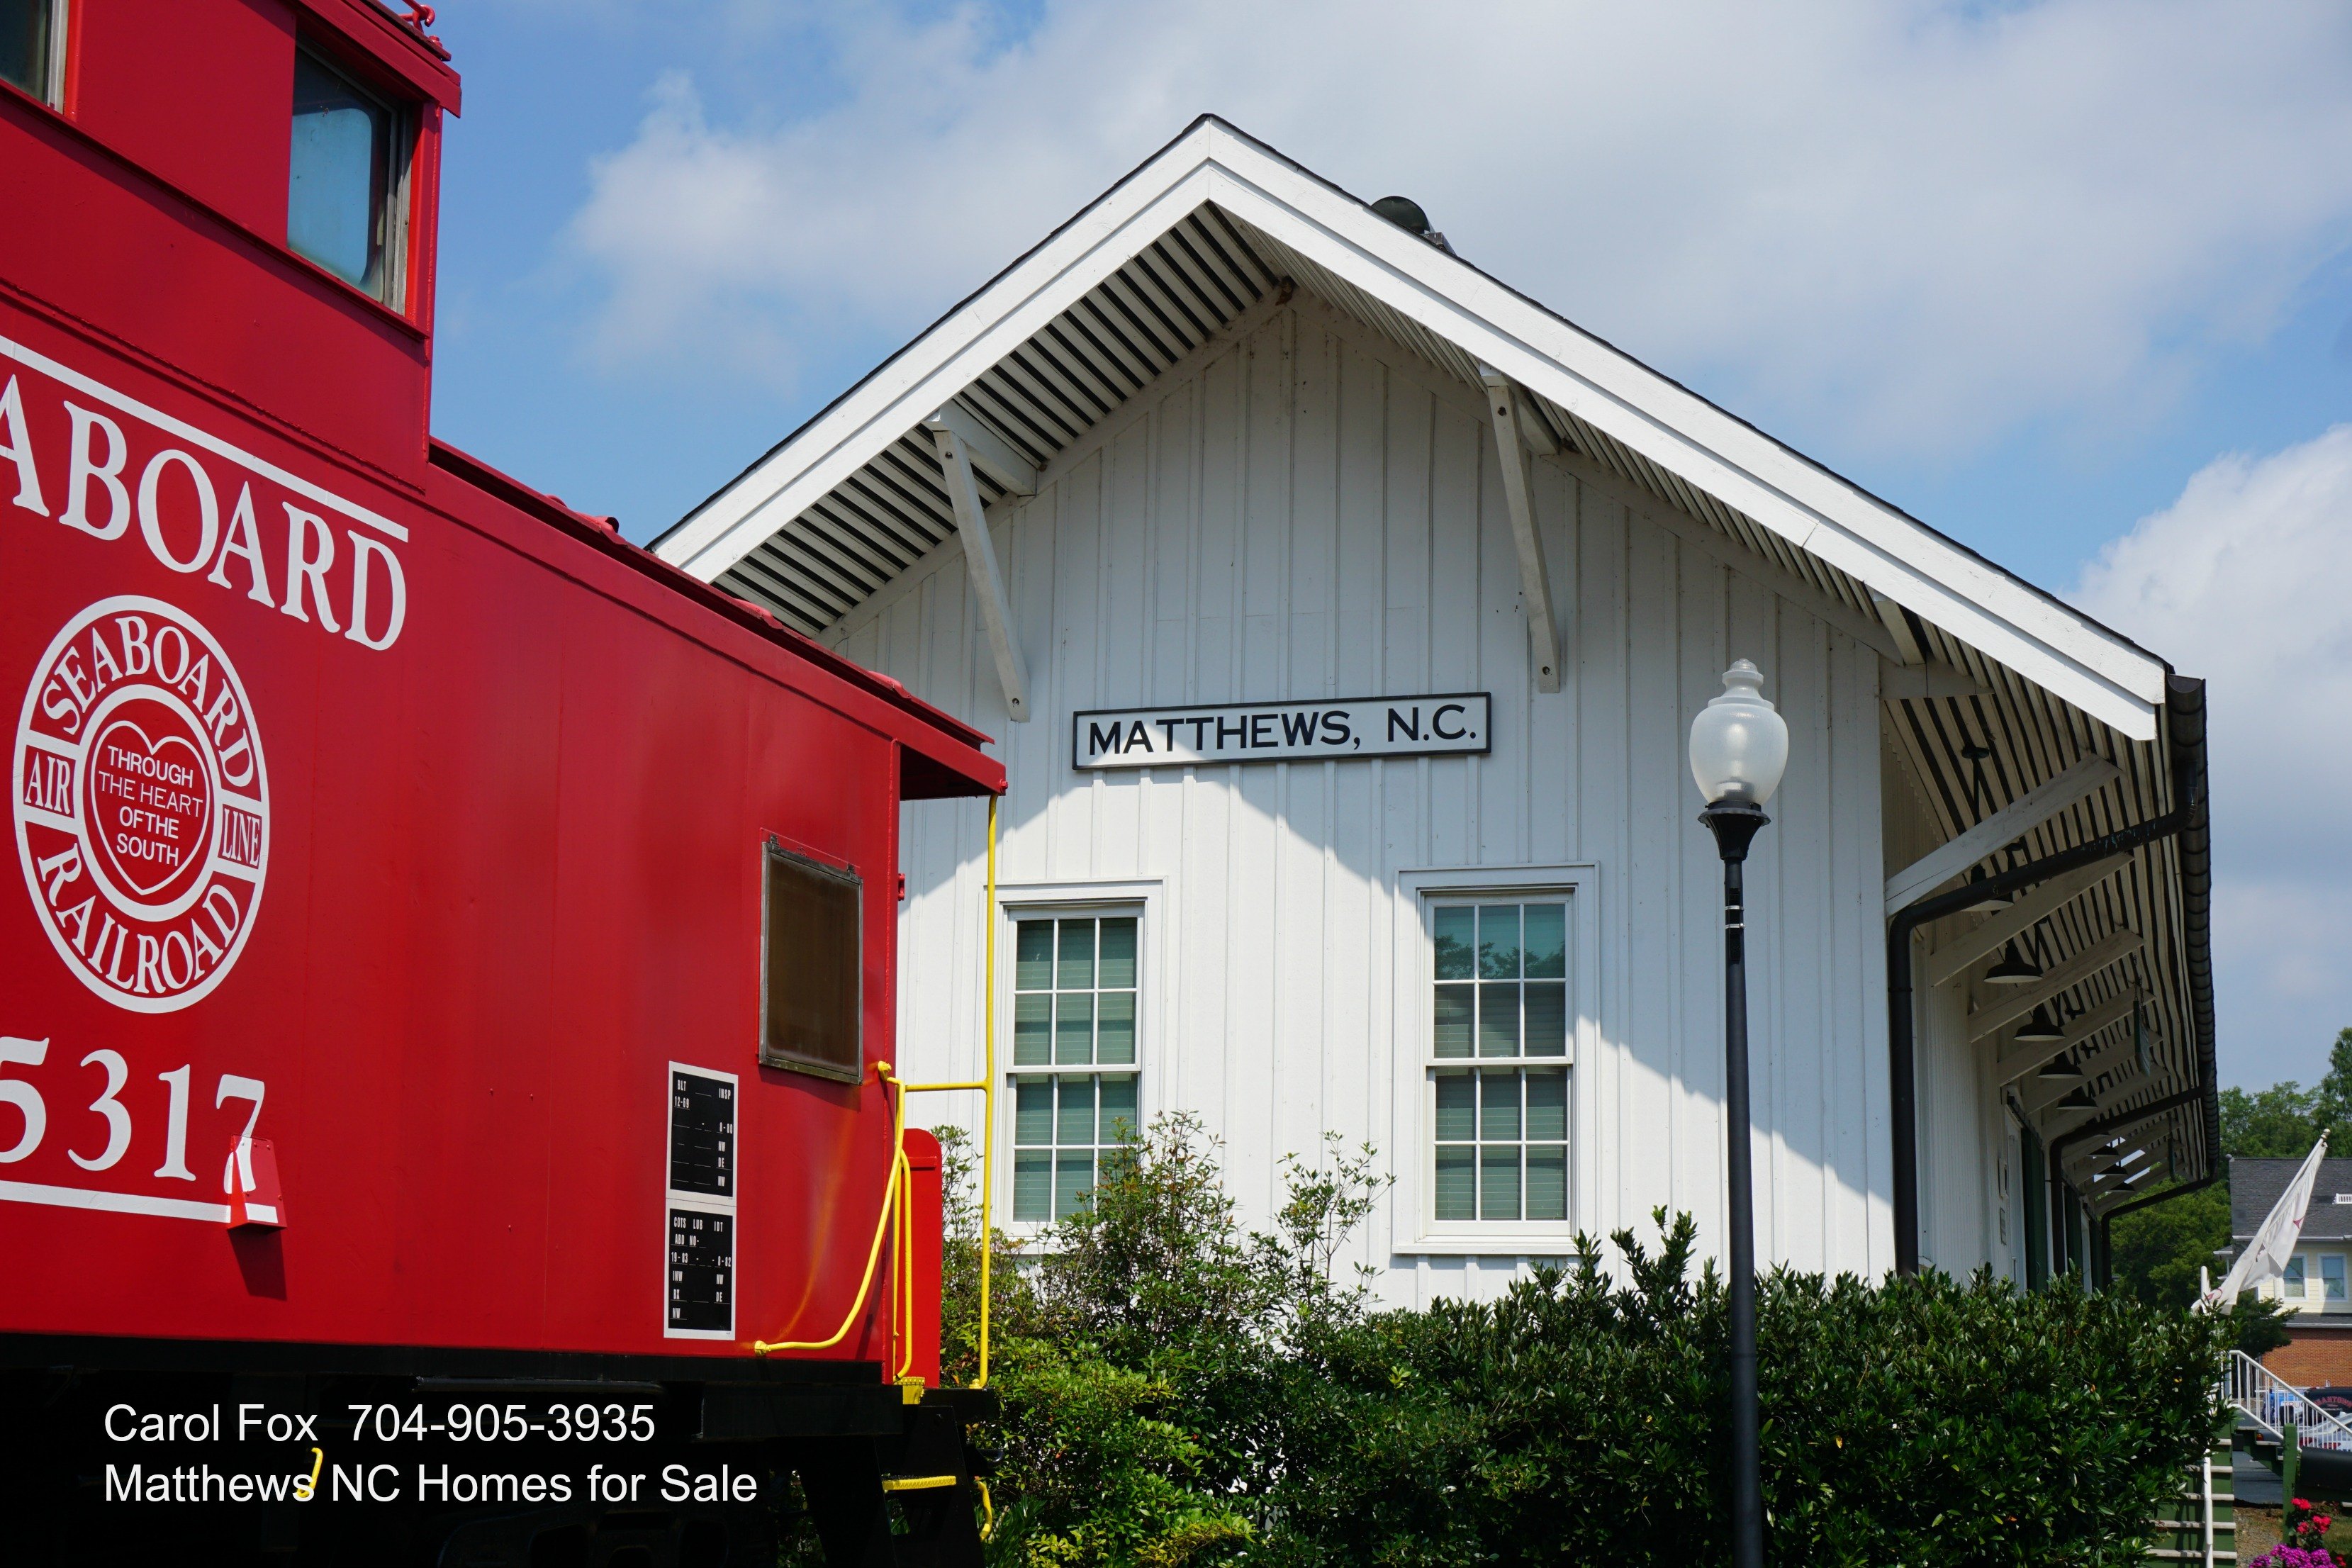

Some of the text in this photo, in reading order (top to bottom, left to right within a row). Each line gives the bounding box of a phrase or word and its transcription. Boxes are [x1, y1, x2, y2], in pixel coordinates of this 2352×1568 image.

[43, 615, 254, 788] SEABOARD
[1088, 703, 1477, 756] MATTHEWS, N.C.
[25, 752, 70, 815] AIR
[108, 745, 194, 788] THROUGH
[99, 771, 203, 817] THE HEART
[116, 833, 179, 867] SOUTH
[223, 808, 261, 867] LINE
[38, 842, 240, 995] RAILROAD
[677, 1079, 687, 1092] BLT
[719, 1087, 732, 1100] INSP
[673, 1216, 686, 1228] COTS
[693, 1219, 703, 1231] LUB
[714, 1221, 723, 1233] IDT
